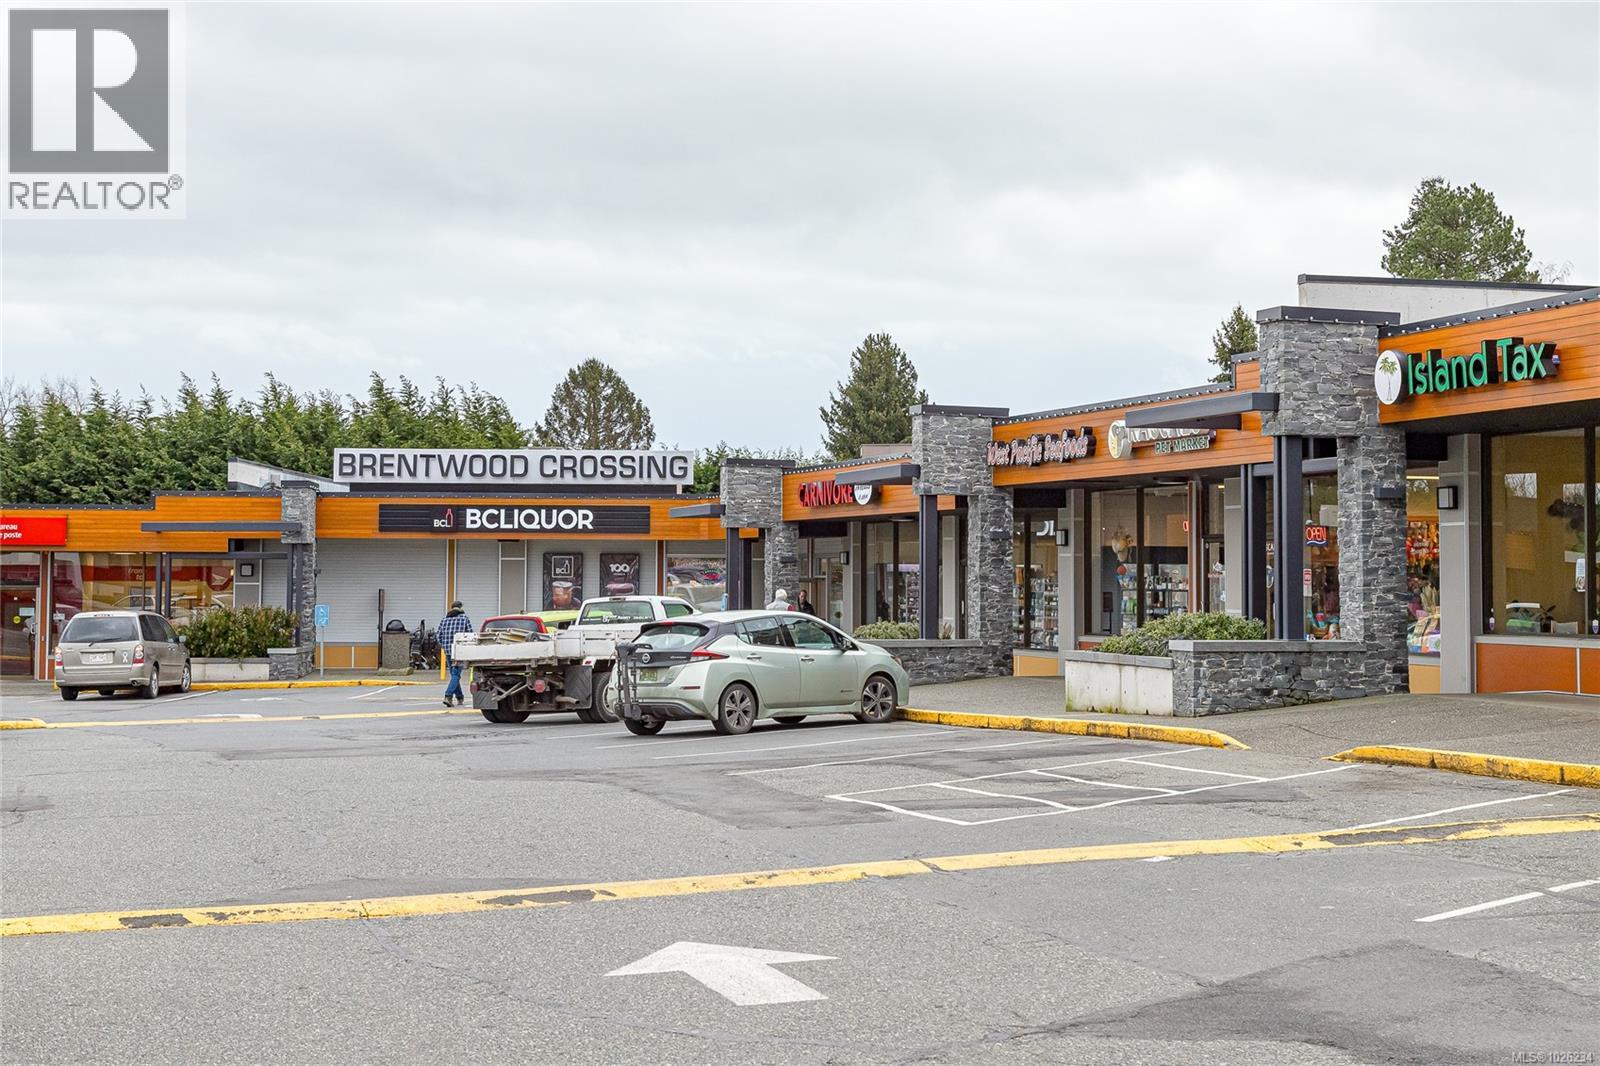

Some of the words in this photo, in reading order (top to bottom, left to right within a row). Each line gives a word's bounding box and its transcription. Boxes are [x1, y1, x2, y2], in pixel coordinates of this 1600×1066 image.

[1407, 340, 1488, 396] Island
[1497, 338, 1548, 382] Tax
[987, 440, 1010, 466] West
[1010, 434, 1042, 467] Pacific
[1044, 427, 1089, 463] Seafoods
[1155, 440, 1171, 455] PET
[1172, 435, 1211, 452] MARKET
[337, 453, 529, 478] BRENTWOOD
[540, 454, 689, 479] CROSSING
[466, 508, 594, 530] BCLIQUOR
[3, 532, 23, 540] poste
[1306, 526, 1327, 541] OPEN
